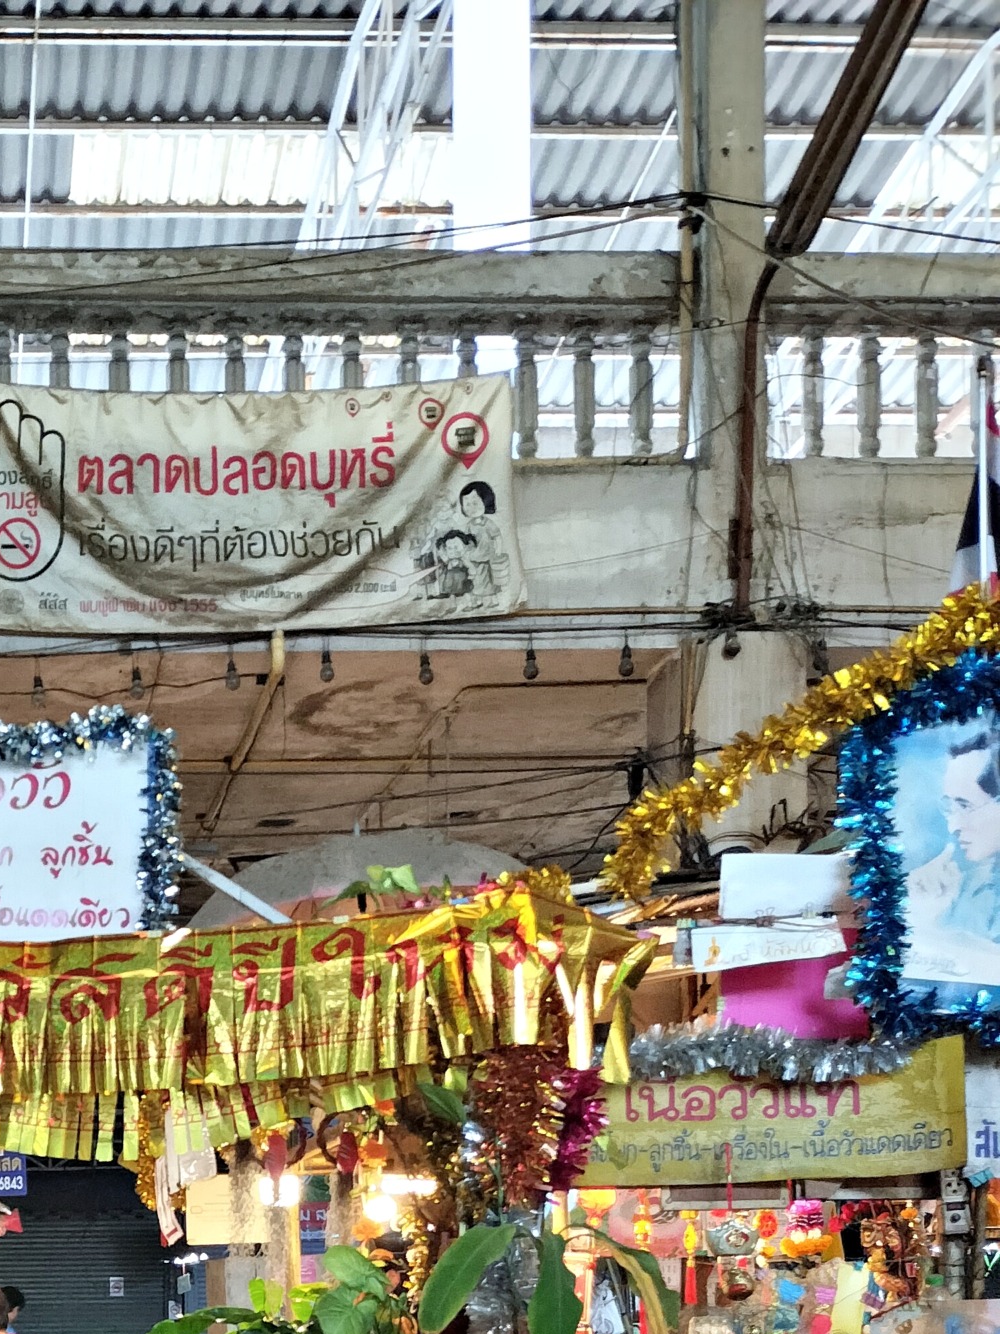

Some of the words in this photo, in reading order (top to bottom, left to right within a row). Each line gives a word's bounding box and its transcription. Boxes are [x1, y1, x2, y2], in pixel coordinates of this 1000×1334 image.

[77, 421, 396, 508] ตลาดปลอดบุหรี่
[40, 821, 114, 879] ลูกชิ้น
